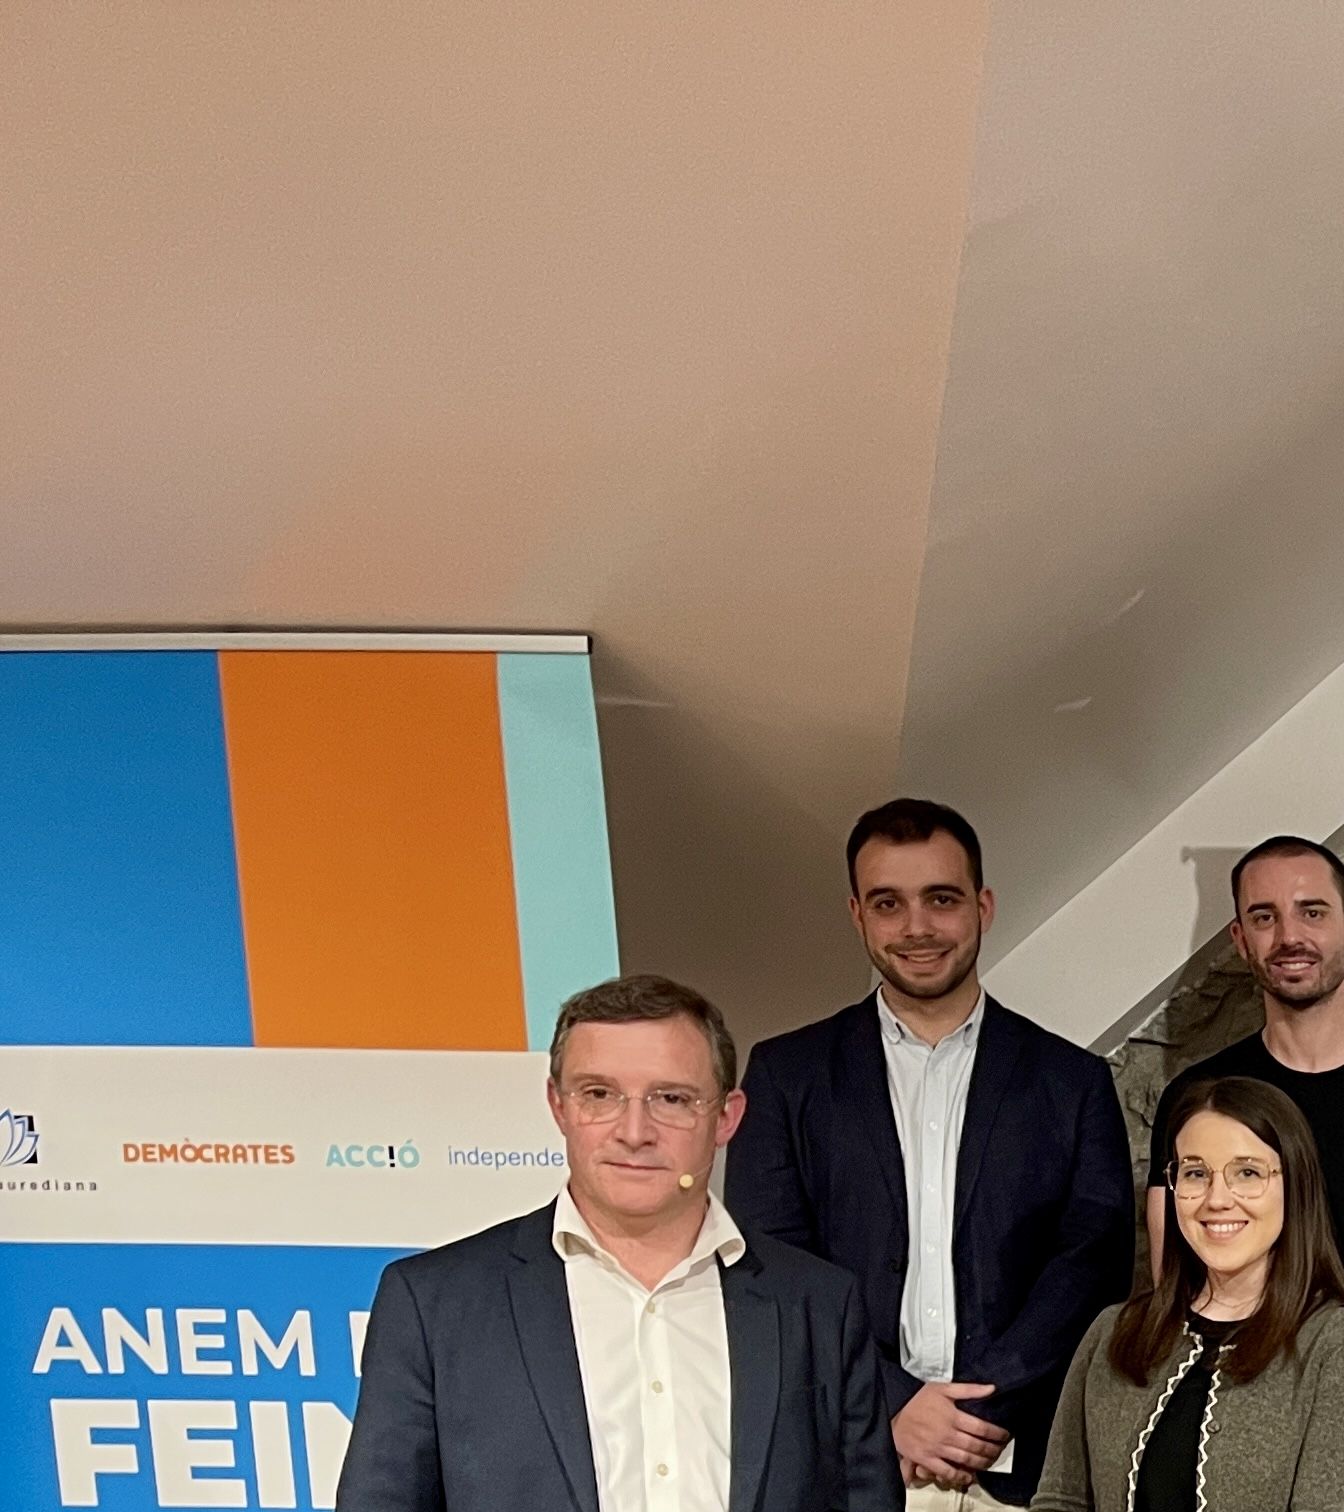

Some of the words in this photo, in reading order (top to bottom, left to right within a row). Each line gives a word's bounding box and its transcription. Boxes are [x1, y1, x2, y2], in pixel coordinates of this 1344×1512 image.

[122, 1137, 297, 1164] DEMÒCRATES
[447, 1145, 565, 1170] independe
[32, 1307, 316, 1377] ANEM
